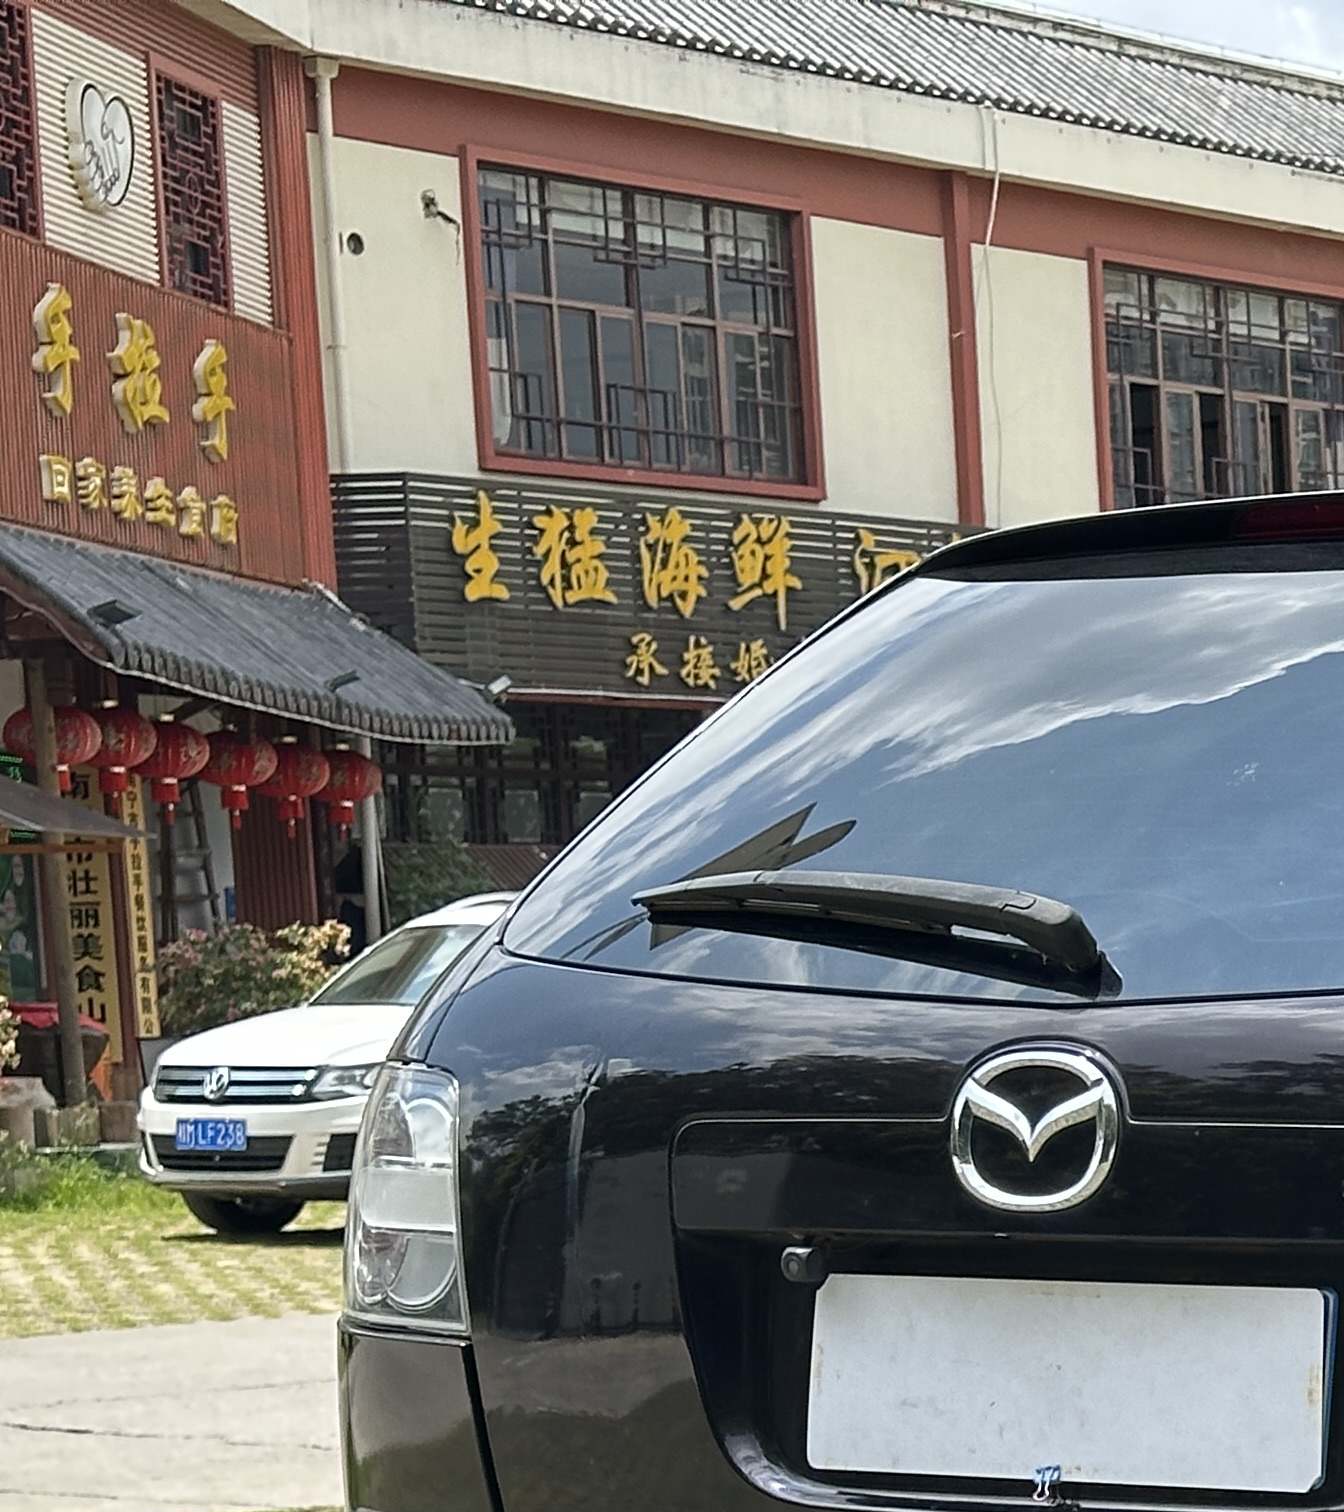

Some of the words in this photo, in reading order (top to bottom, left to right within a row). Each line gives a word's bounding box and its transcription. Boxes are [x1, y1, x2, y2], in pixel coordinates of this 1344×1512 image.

[452, 489, 802, 631] 生猛海鲜
[624, 632, 768, 690] 承接婚
[61, 770, 107, 1023] 南市壮丽美食山
